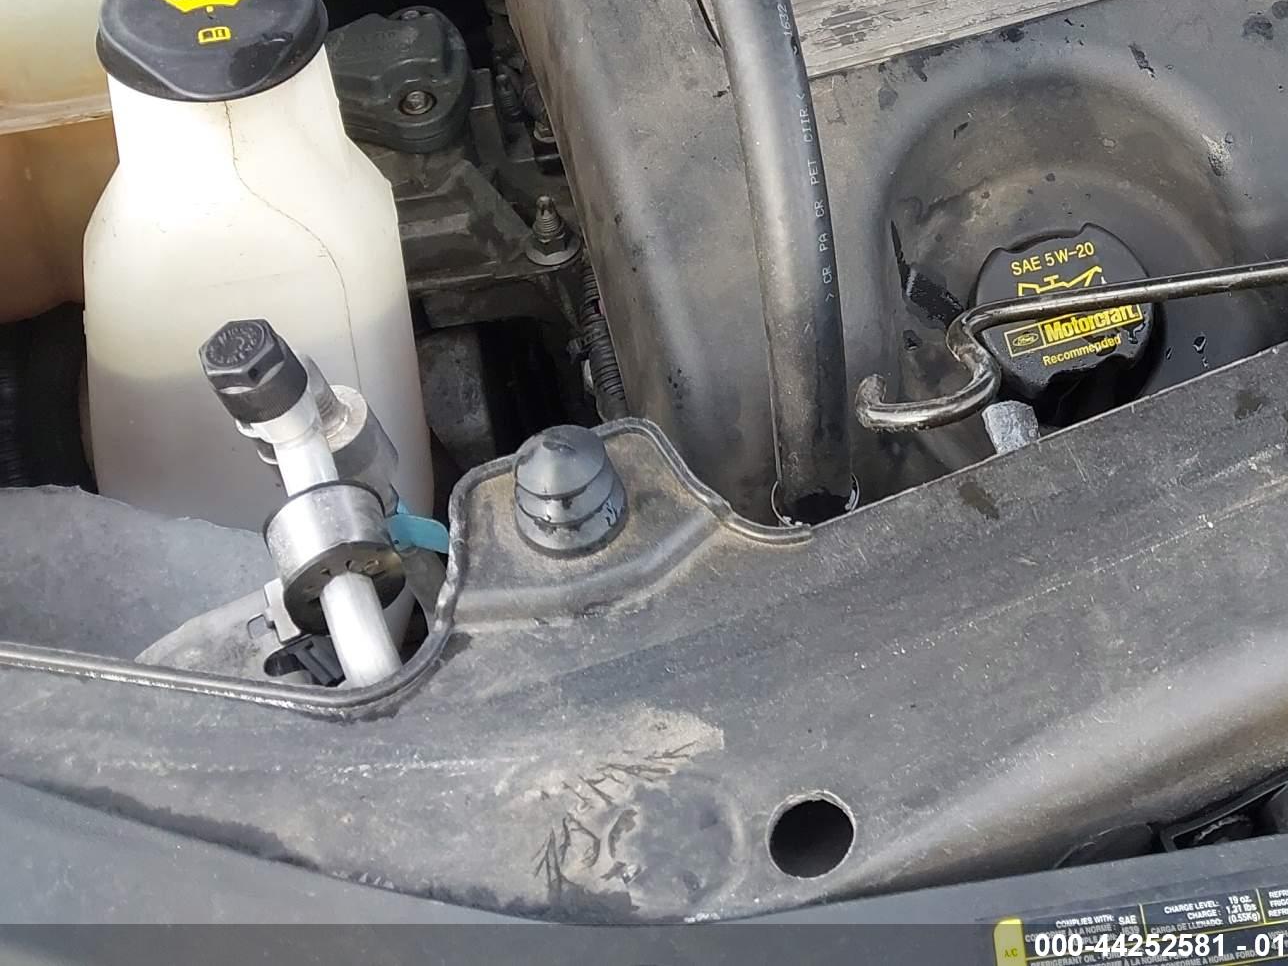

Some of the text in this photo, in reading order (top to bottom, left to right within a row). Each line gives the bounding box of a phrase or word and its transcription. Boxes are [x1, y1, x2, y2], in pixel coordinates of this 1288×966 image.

[807, 159, 820, 187] PET
[818, 232, 829, 252] PA
[1011, 256, 1042, 276] SAE
[1042, 333, 1122, 367] Recommended
[1228, 896, 1238, 904] 19
[1164, 903, 1194, 914] CHARGE
[1118, 915, 1137, 925] SAE
[1187, 910, 1217, 920] CHARGE
[1056, 916, 1093, 929] COMPLIES
[1151, 924, 1176, 934] CARGA
[1178, 923, 1187, 931] DE
